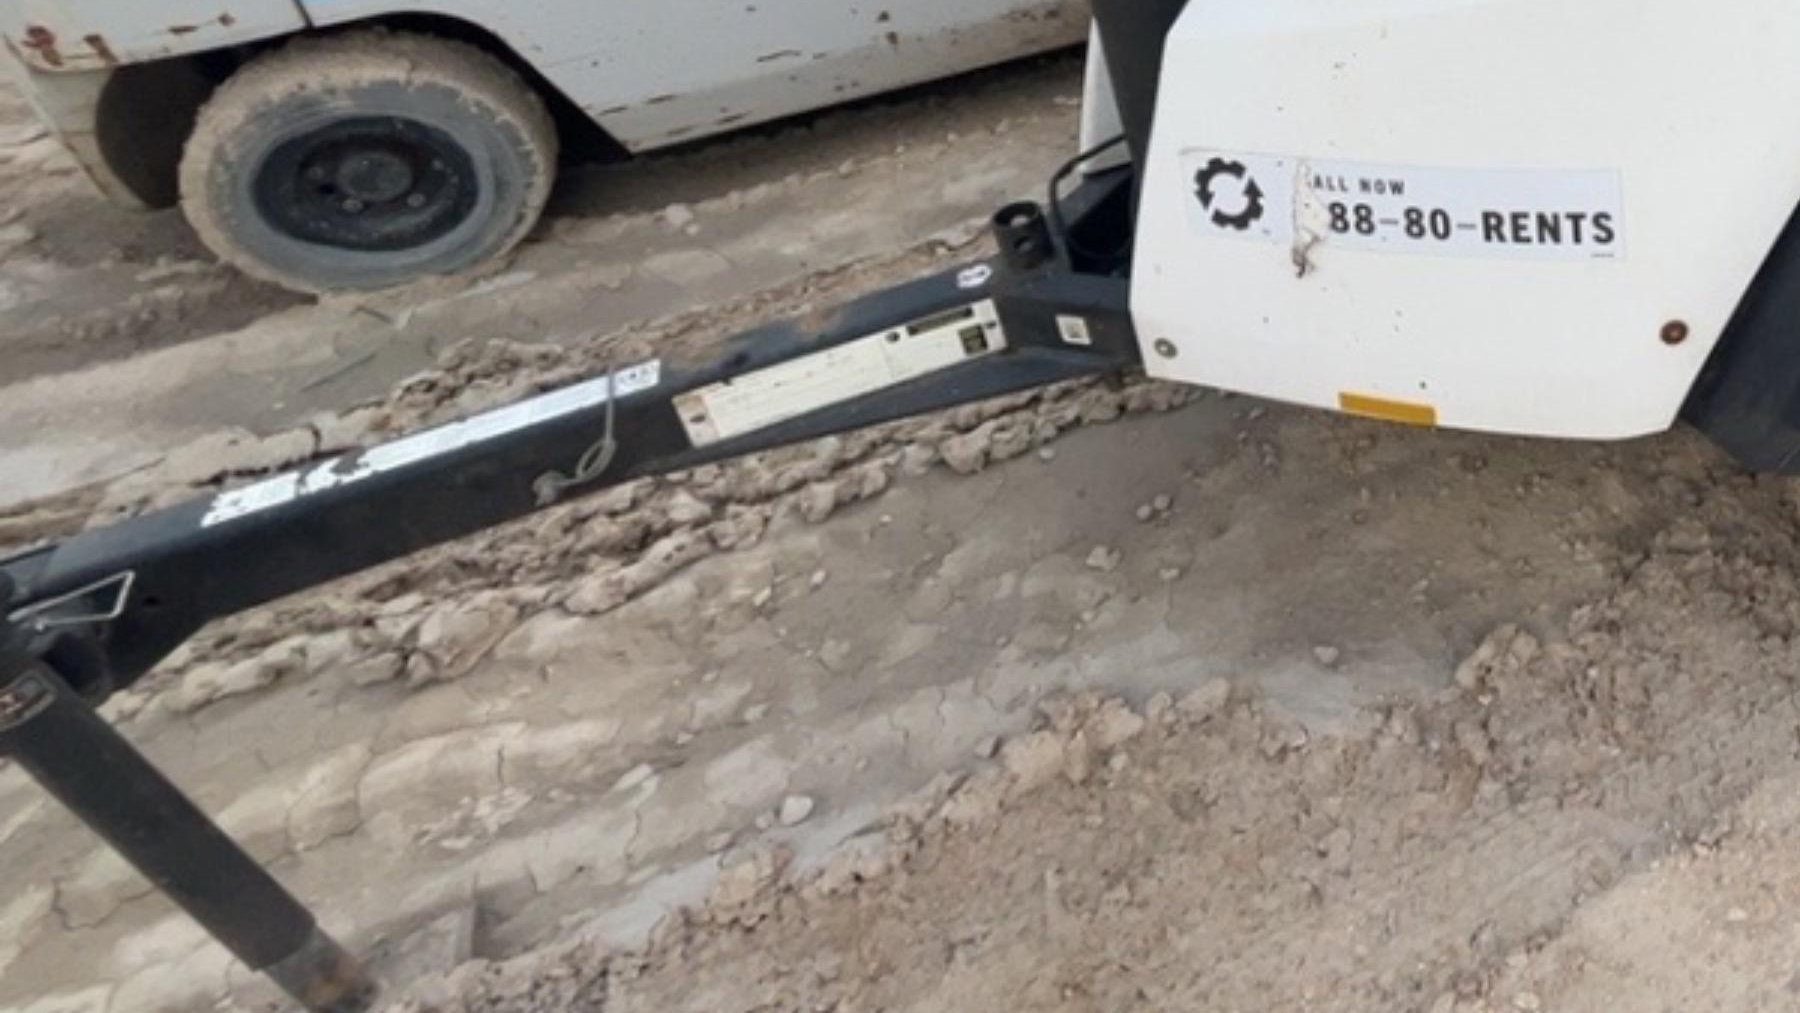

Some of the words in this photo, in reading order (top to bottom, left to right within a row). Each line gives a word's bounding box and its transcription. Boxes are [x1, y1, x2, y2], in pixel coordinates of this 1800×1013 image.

[1311, 173, 1349, 193] ALL
[1358, 177, 1406, 196] NOW
[1328, 201, 1615, 245] 88-80-RENTS
